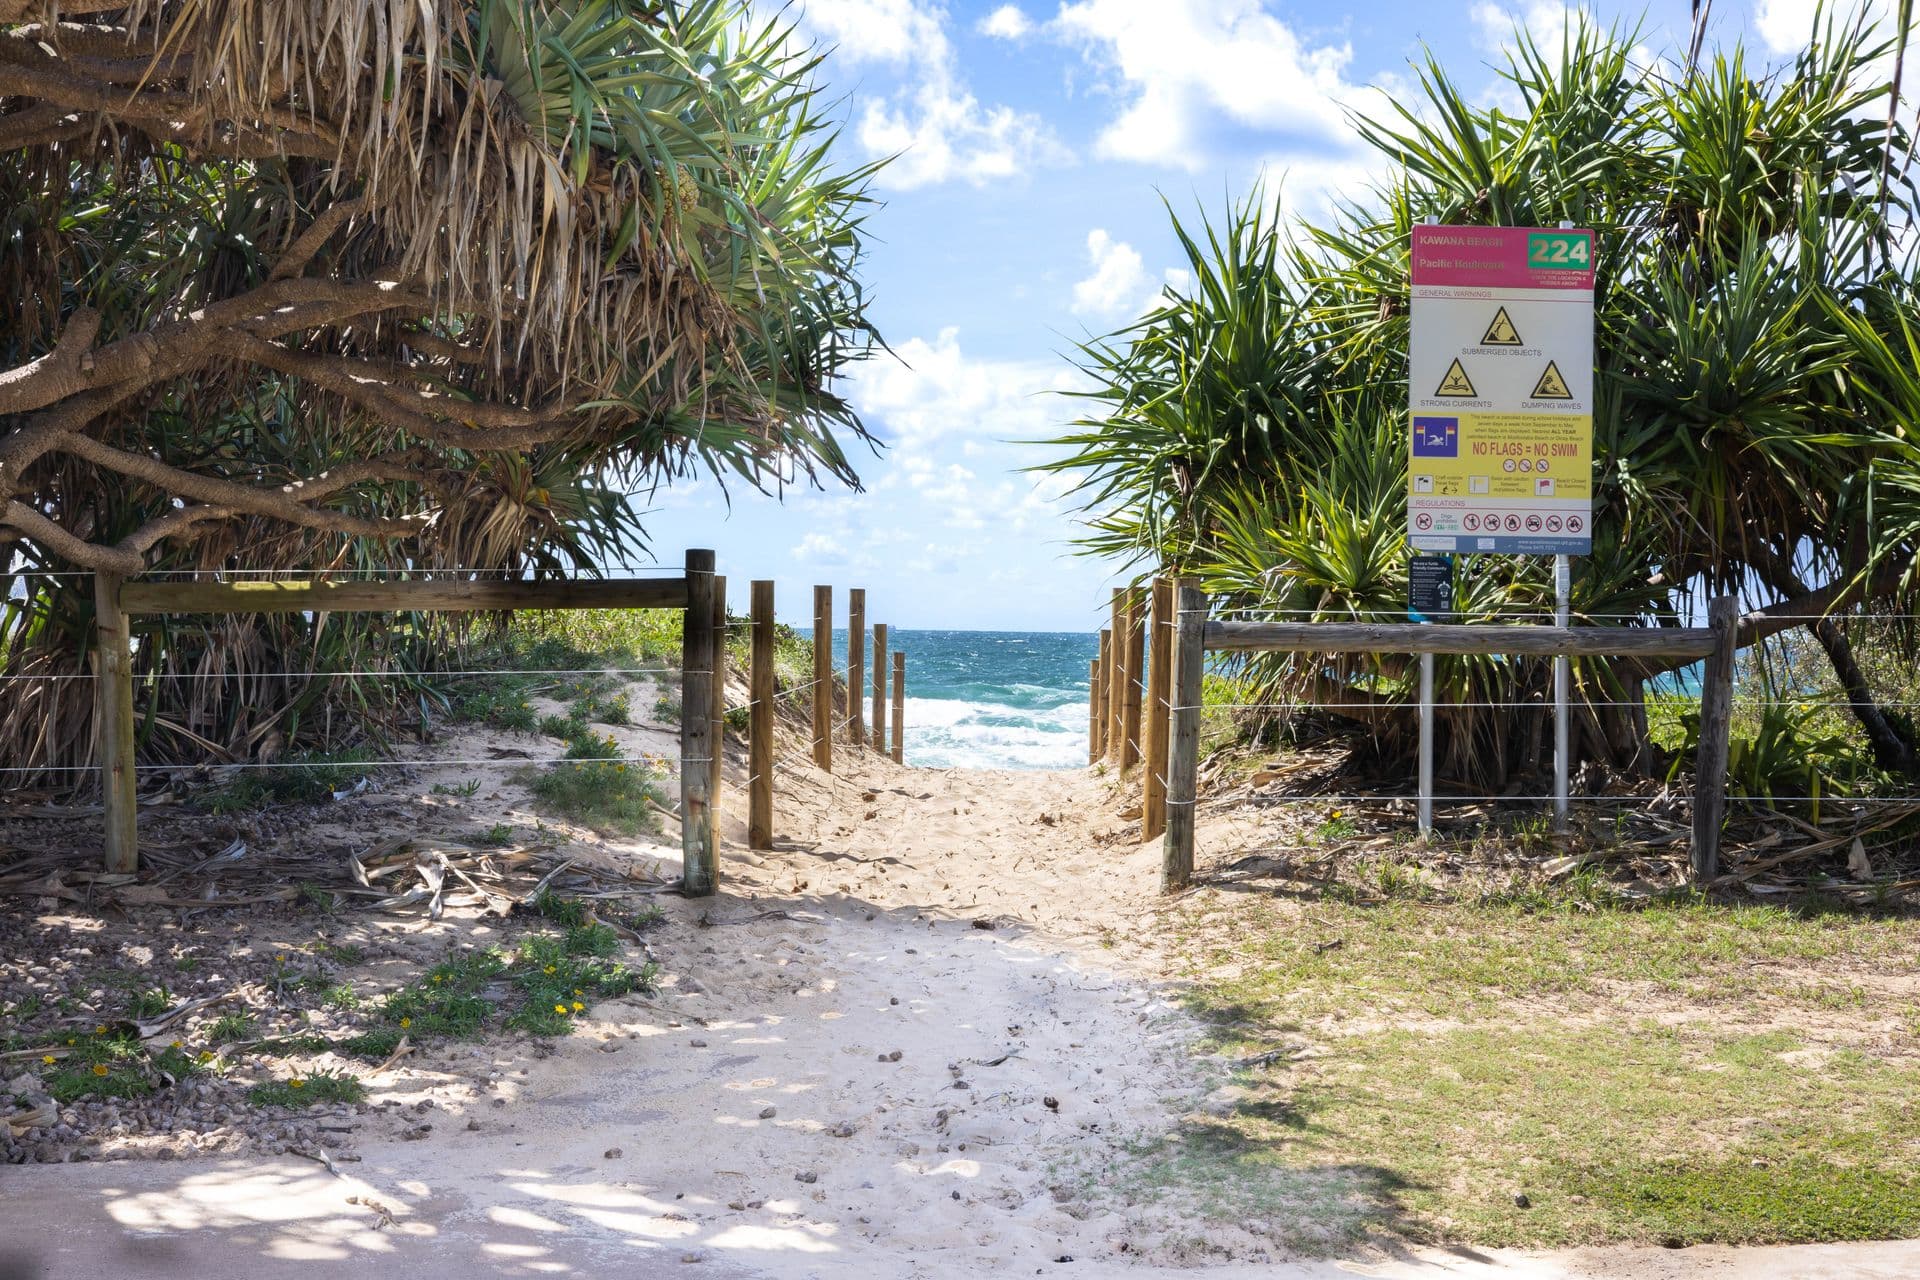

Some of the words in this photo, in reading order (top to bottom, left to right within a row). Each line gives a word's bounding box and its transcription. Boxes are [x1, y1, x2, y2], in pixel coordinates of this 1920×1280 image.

[1420, 235, 1464, 246] KAWANA
[1467, 237, 1503, 248] BEACH
[1532, 239, 1588, 264] 224
[1420, 258, 1453, 269] Pacific
[1455, 259, 1505, 270] Boulevard
[1419, 289, 1452, 297] GENERAL
[1454, 290, 1492, 298] WARNINGS
[1461, 348, 1507, 356] SUBMERGED
[1509, 349, 1542, 357] OBJECTS
[1420, 400, 1452, 408] STRONG
[1453, 400, 1492, 408] CURRENTS
[1555, 402, 1582, 410] WAVES
[1472, 442, 1487, 455] NO
[1490, 442, 1523, 456] FLAGS
[1534, 443, 1548, 457] NO
[1551, 443, 1578, 457] SWIM
